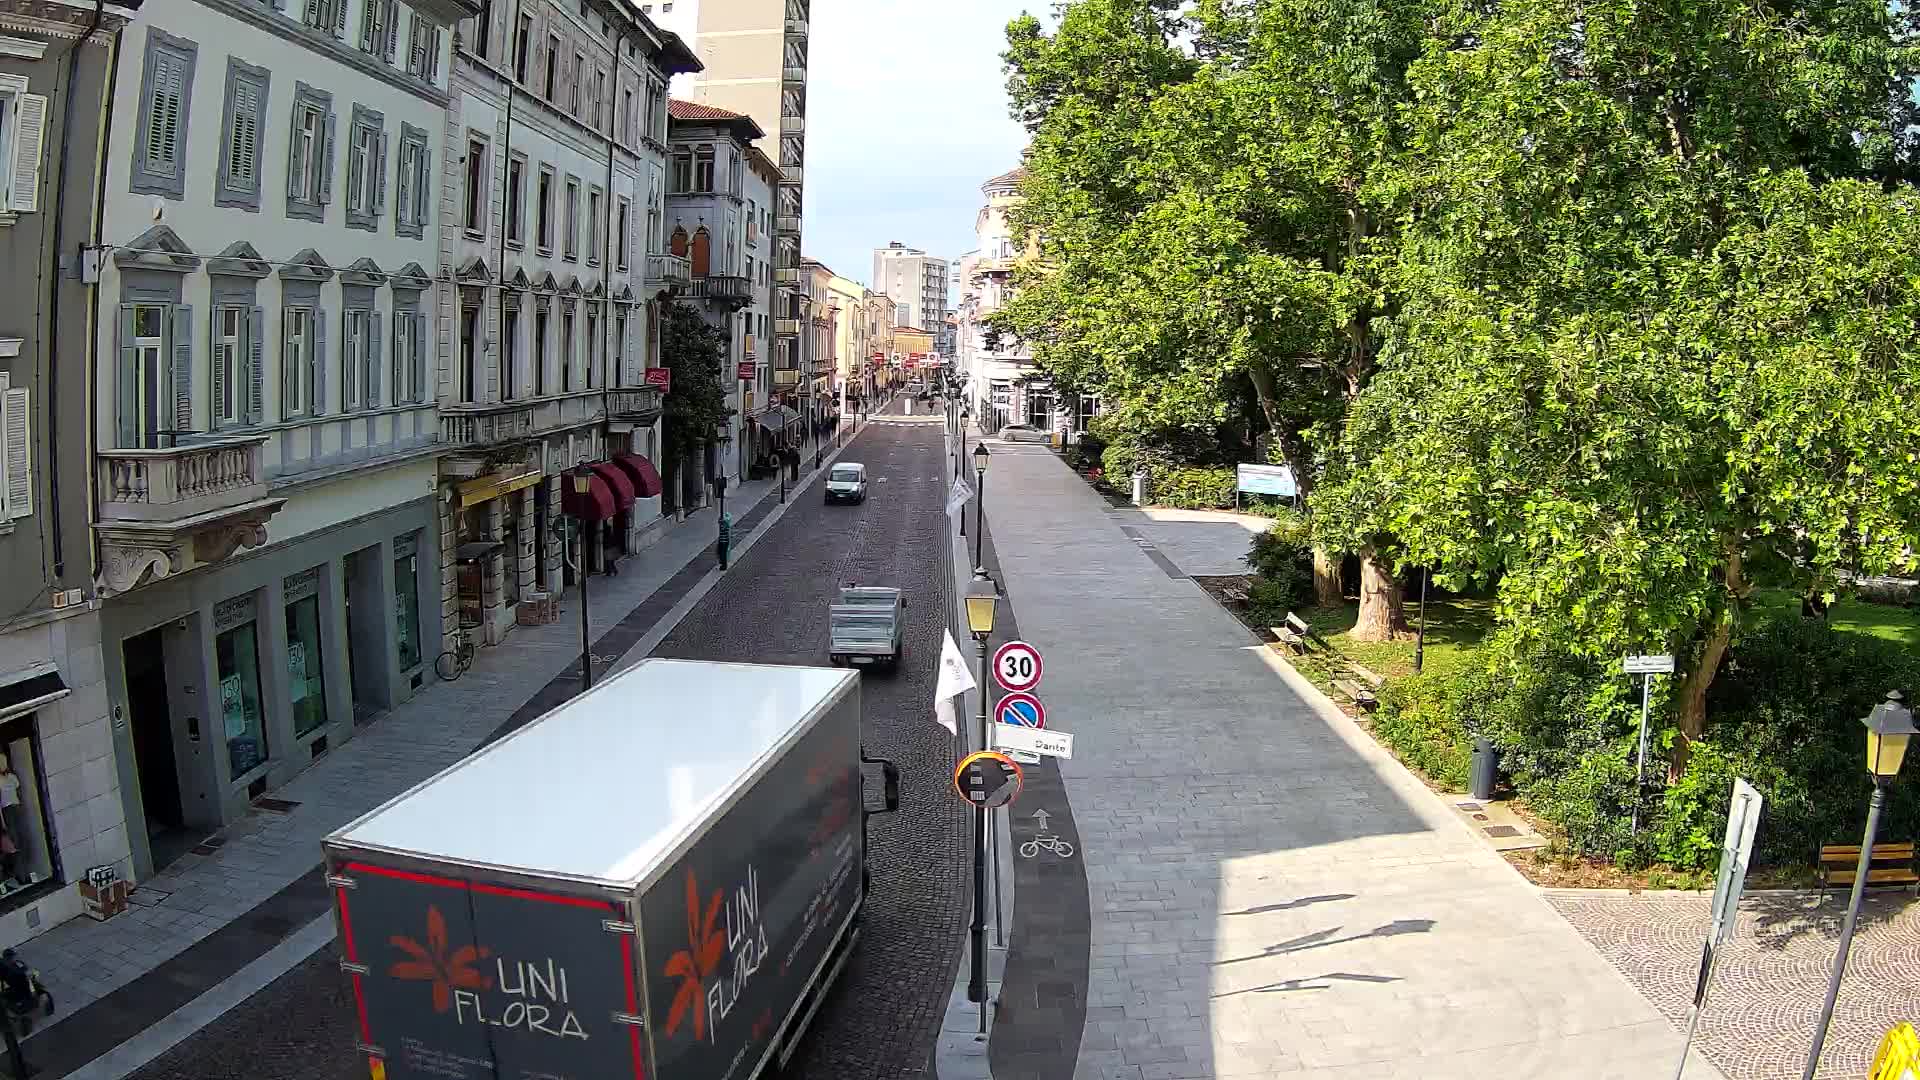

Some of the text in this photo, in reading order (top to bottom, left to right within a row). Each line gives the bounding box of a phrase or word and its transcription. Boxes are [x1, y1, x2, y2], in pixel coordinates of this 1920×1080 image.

[1005, 656, 1032, 678] 30
[1035, 739, 1066, 753] Dante
[725, 863, 760, 953] UNI
[496, 956, 569, 1004] UNI
[707, 924, 769, 1045] FLORA
[453, 989, 590, 1041] FLORA
